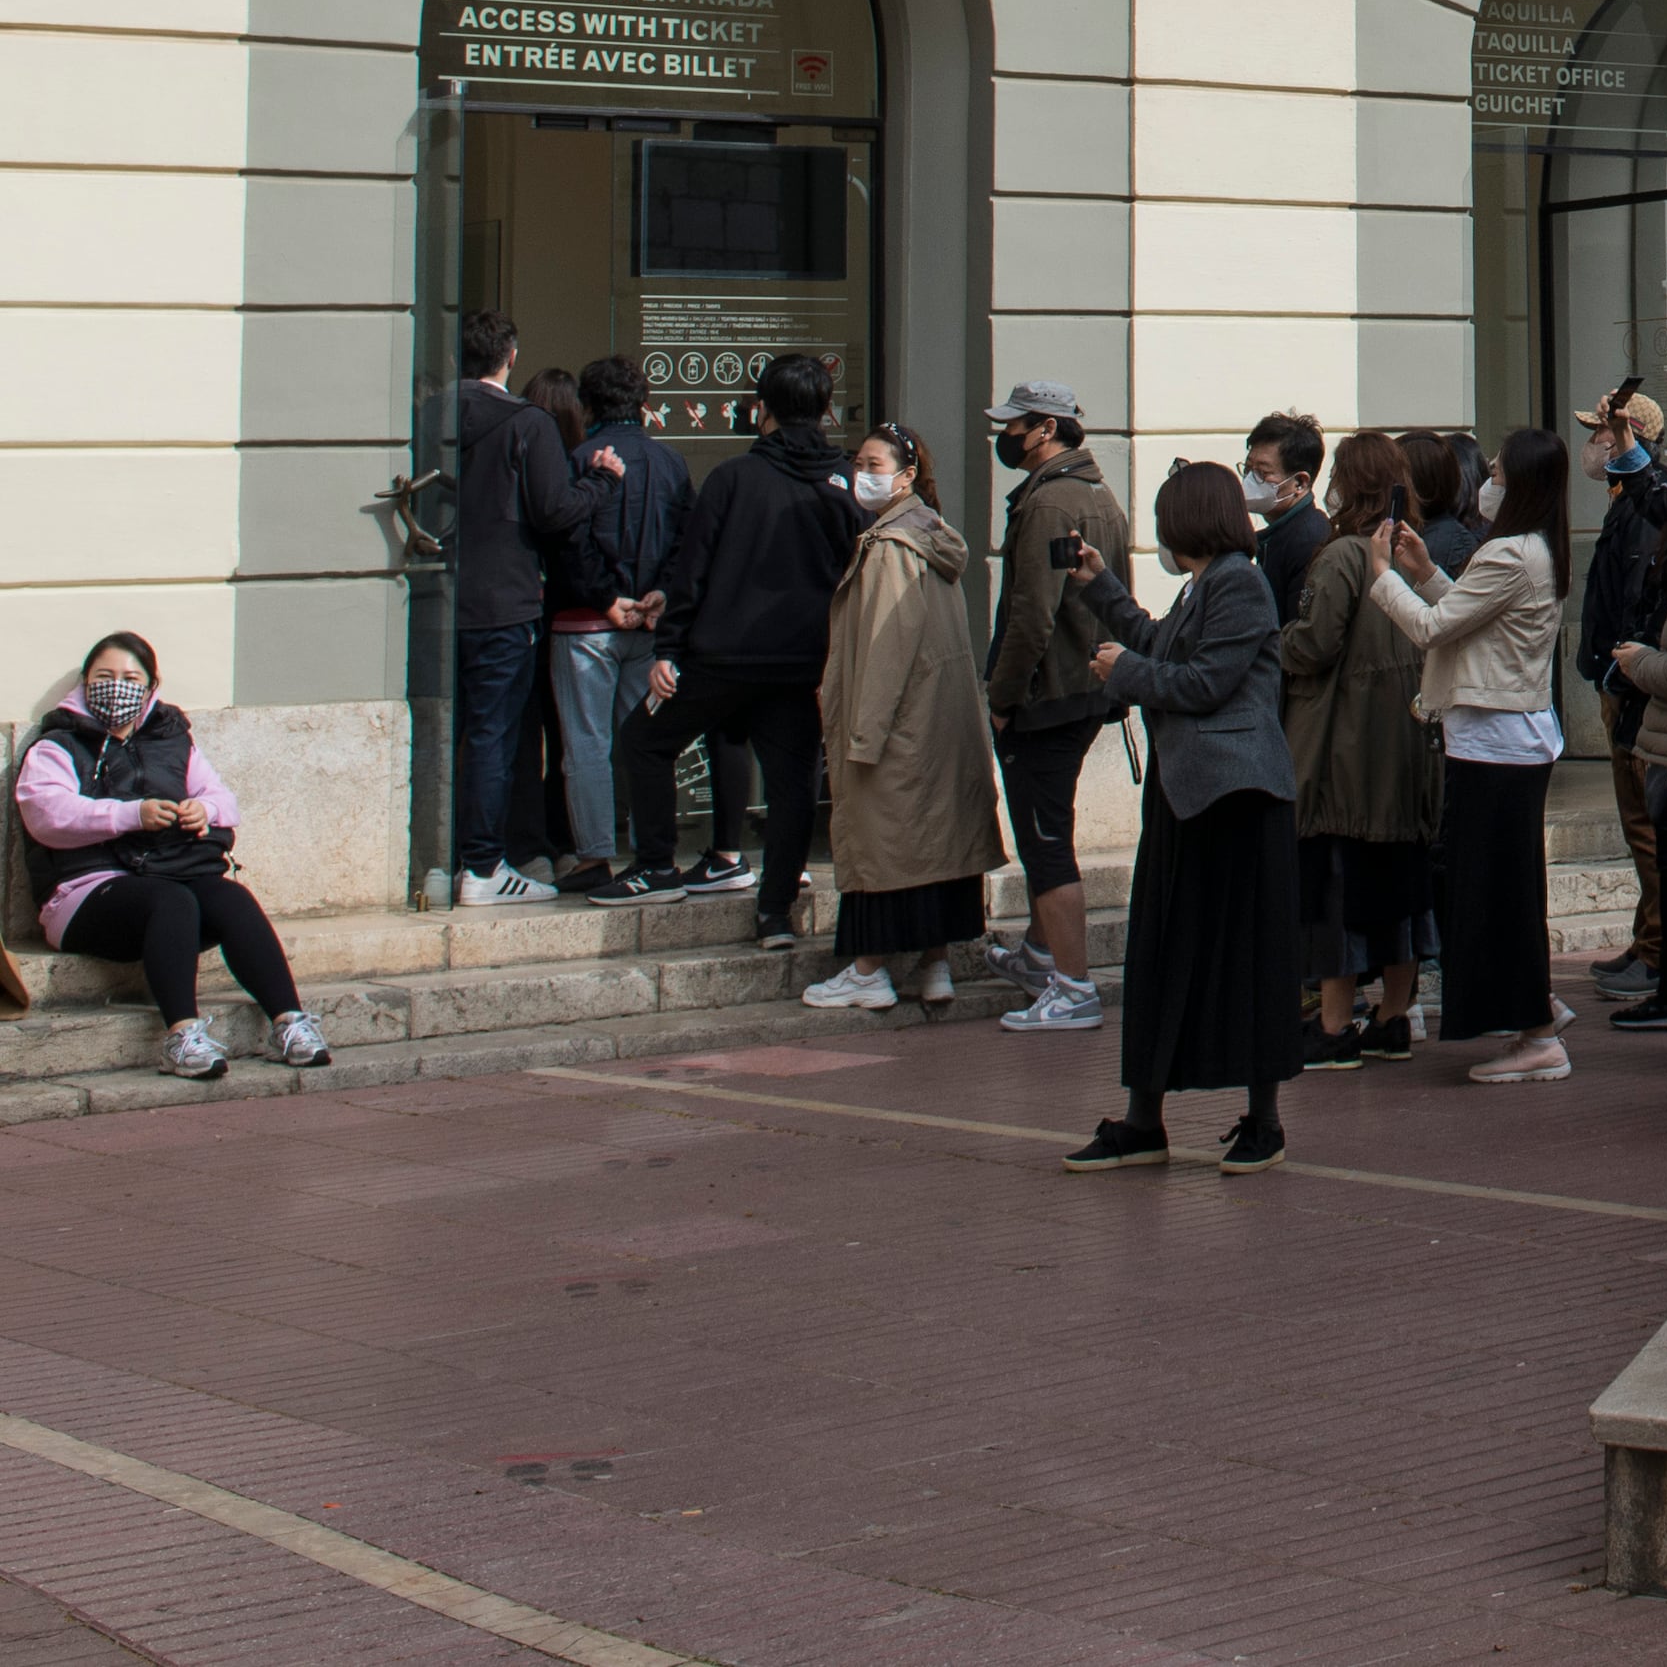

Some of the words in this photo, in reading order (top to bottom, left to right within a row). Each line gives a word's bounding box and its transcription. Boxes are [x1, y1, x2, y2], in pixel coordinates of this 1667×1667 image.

[458, 6, 576, 34] ACCESS
[582, 12, 657, 38] WITH
[661, 17, 764, 44] TICKET
[1474, 31, 1576, 55] TAQUILLA
[464, 42, 577, 70] ENTRÉE
[582, 49, 657, 75] AVEC
[663, 53, 757, 79] BILLET
[1474, 61, 1551, 85] TICKET
[1556, 66, 1626, 88] OFFICE
[1474, 93, 1566, 116] GUICHET
